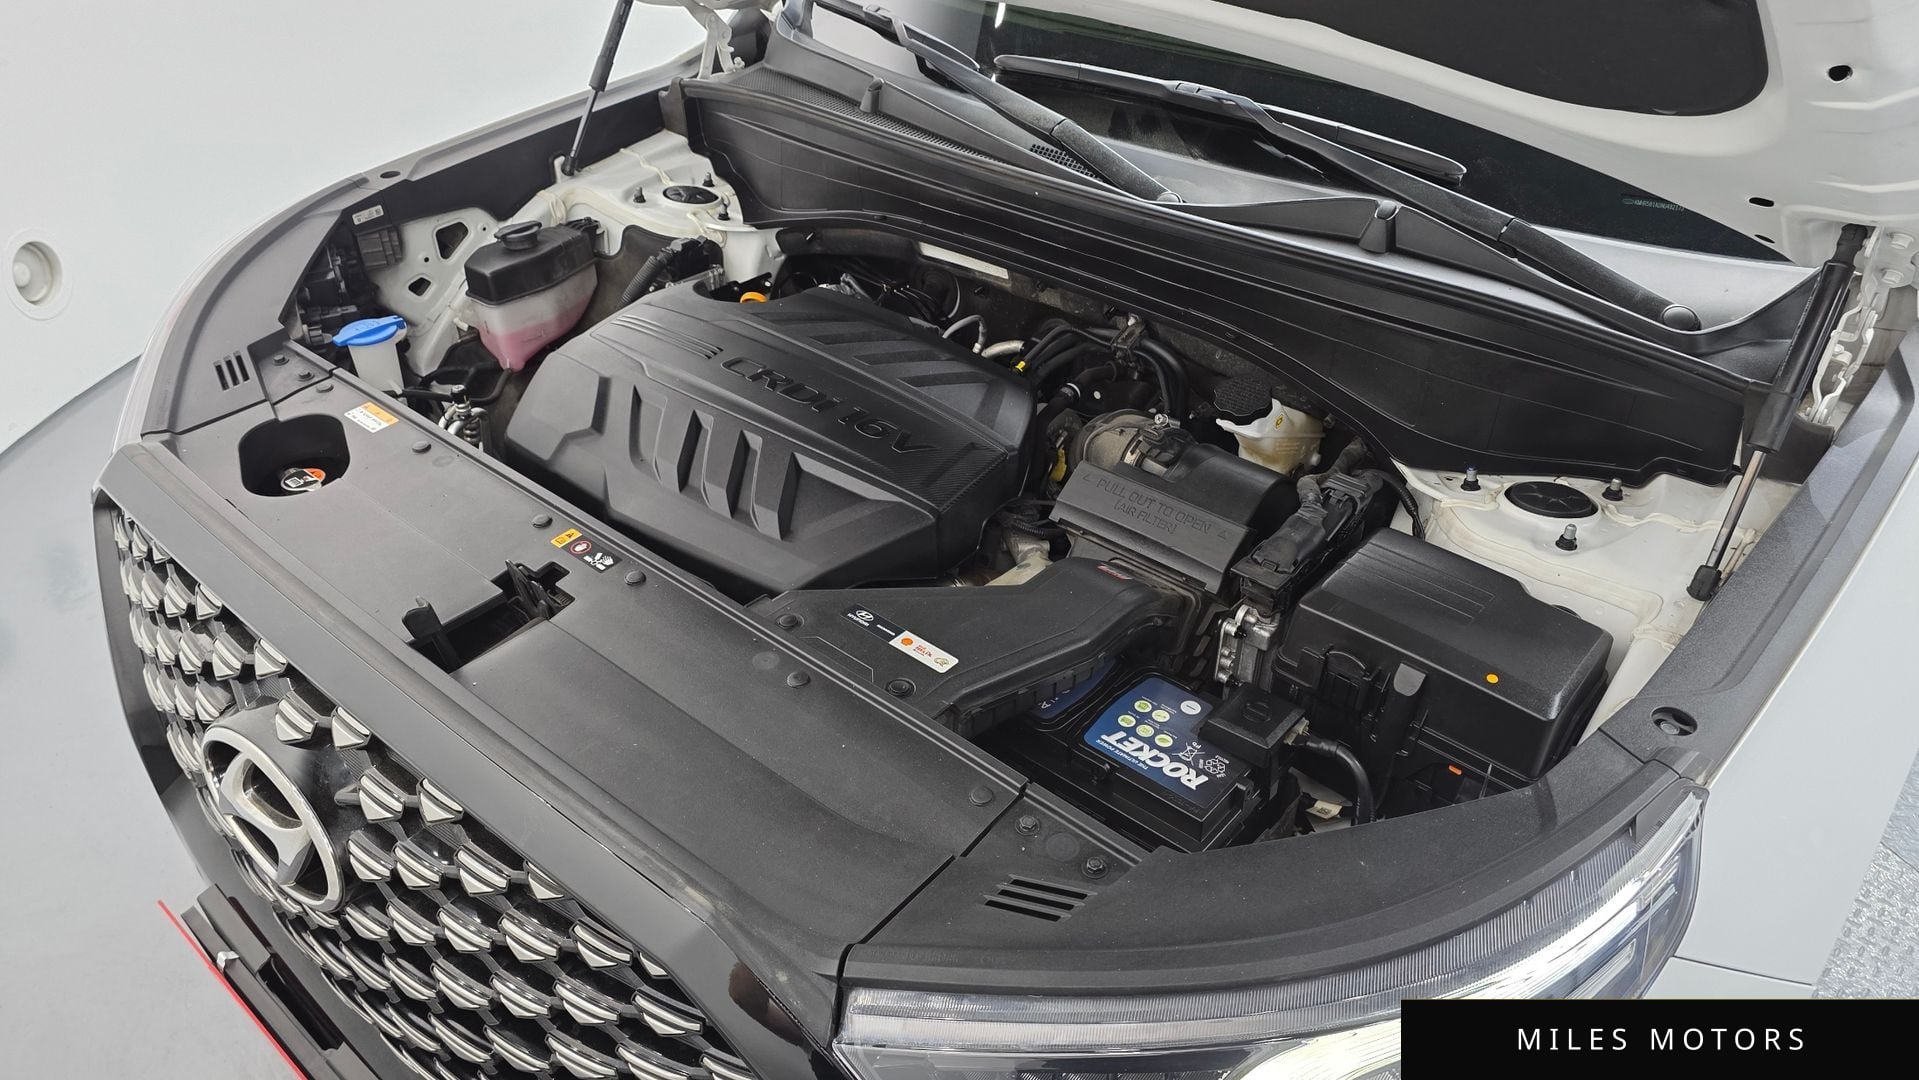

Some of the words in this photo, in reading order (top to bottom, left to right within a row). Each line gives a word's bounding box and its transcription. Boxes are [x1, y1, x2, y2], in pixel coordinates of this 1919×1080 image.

[837, 406, 937, 454] 16V
[1096, 478, 1126, 499] PULL
[1128, 490, 1156, 509] OUT
[1156, 500, 1175, 519] TO
[1174, 510, 1213, 534] OPEN
[1113, 501, 1137, 518] (AIR
[1136, 510, 1178, 535] FILTER)
[1095, 739, 1115, 752] POWER
[1100, 730, 1209, 791] ROCKET
[1113, 750, 1139, 765] ULTIMATE
